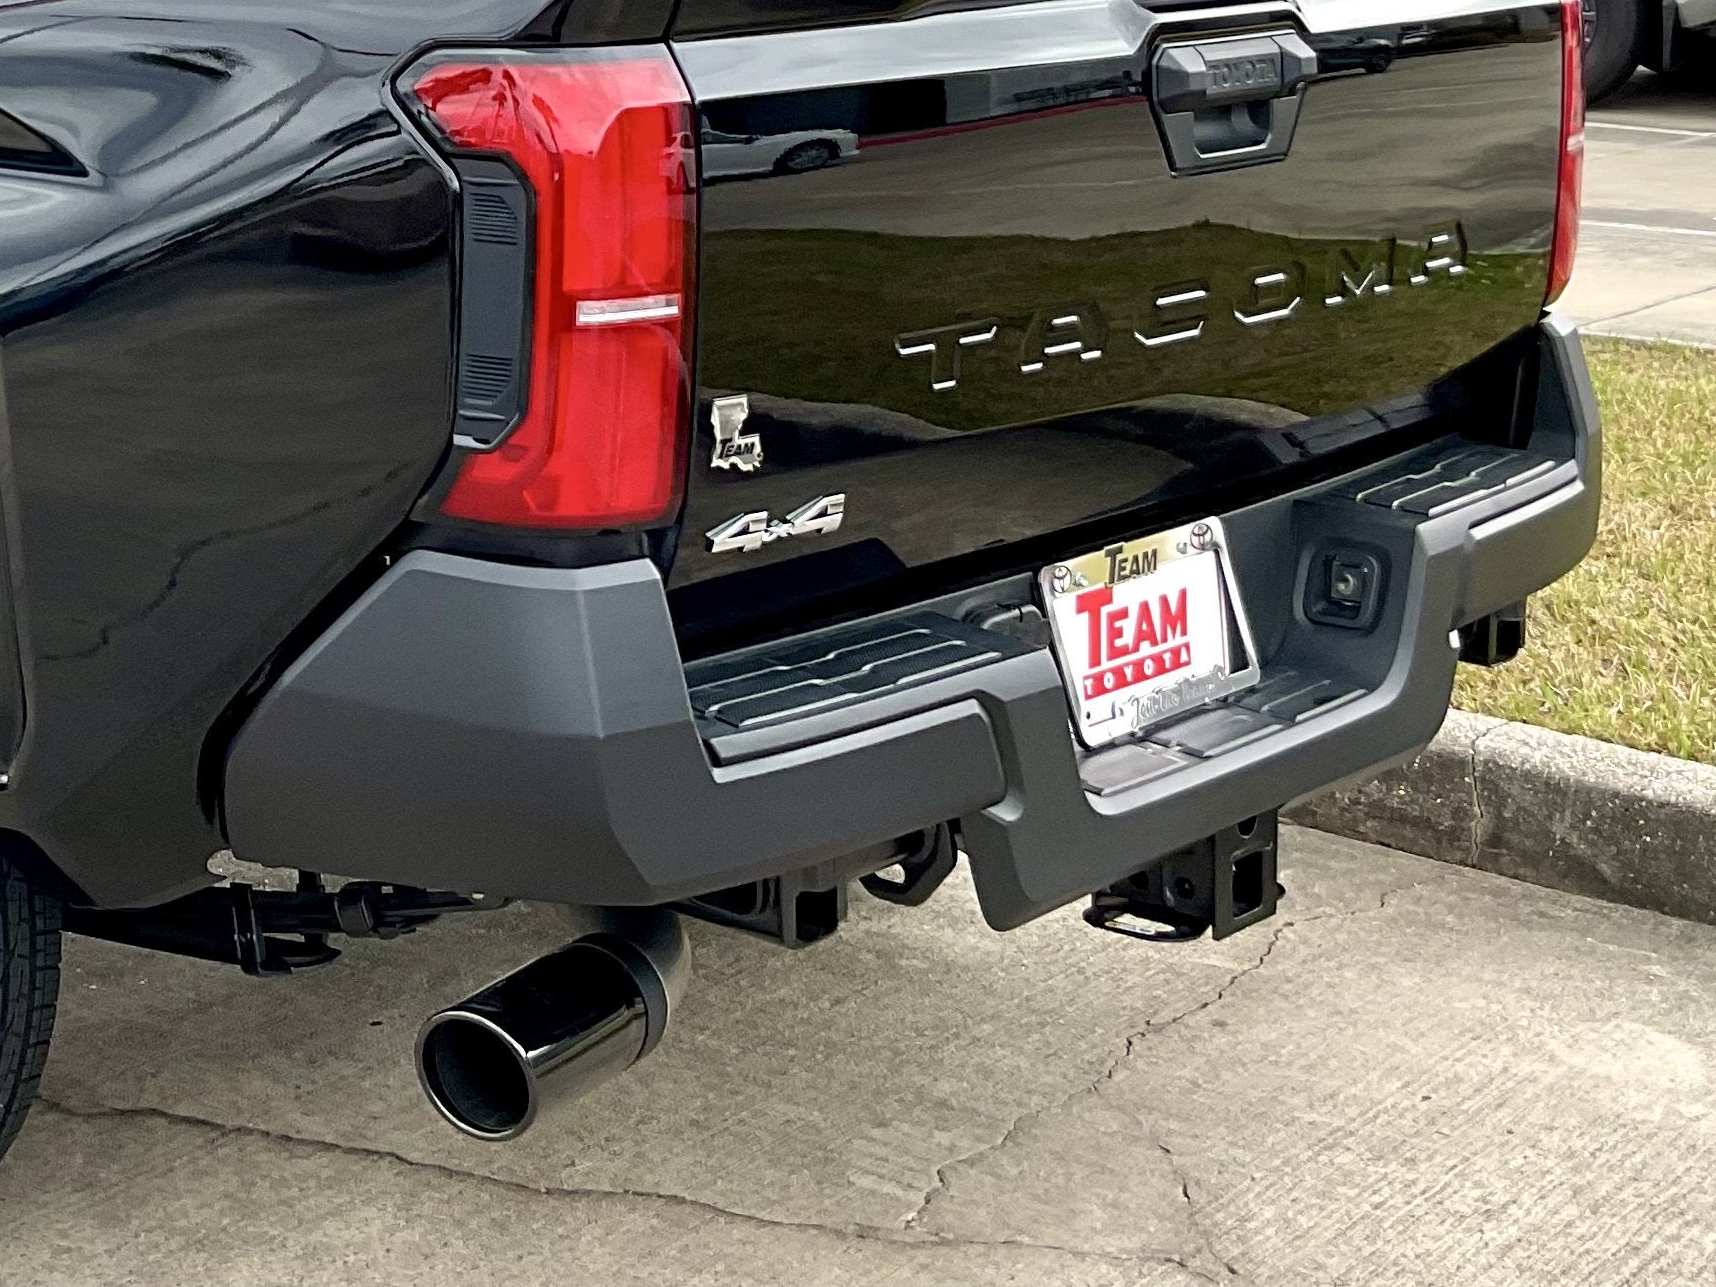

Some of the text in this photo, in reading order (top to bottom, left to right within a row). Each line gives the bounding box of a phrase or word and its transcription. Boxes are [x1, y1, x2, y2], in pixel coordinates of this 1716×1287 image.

[1206, 58, 1278, 89] TOYOTA
[894, 218, 1468, 393] TACOMA
[1075, 587, 1188, 669] TEAM
[1083, 645, 1190, 696] TOYOTA
